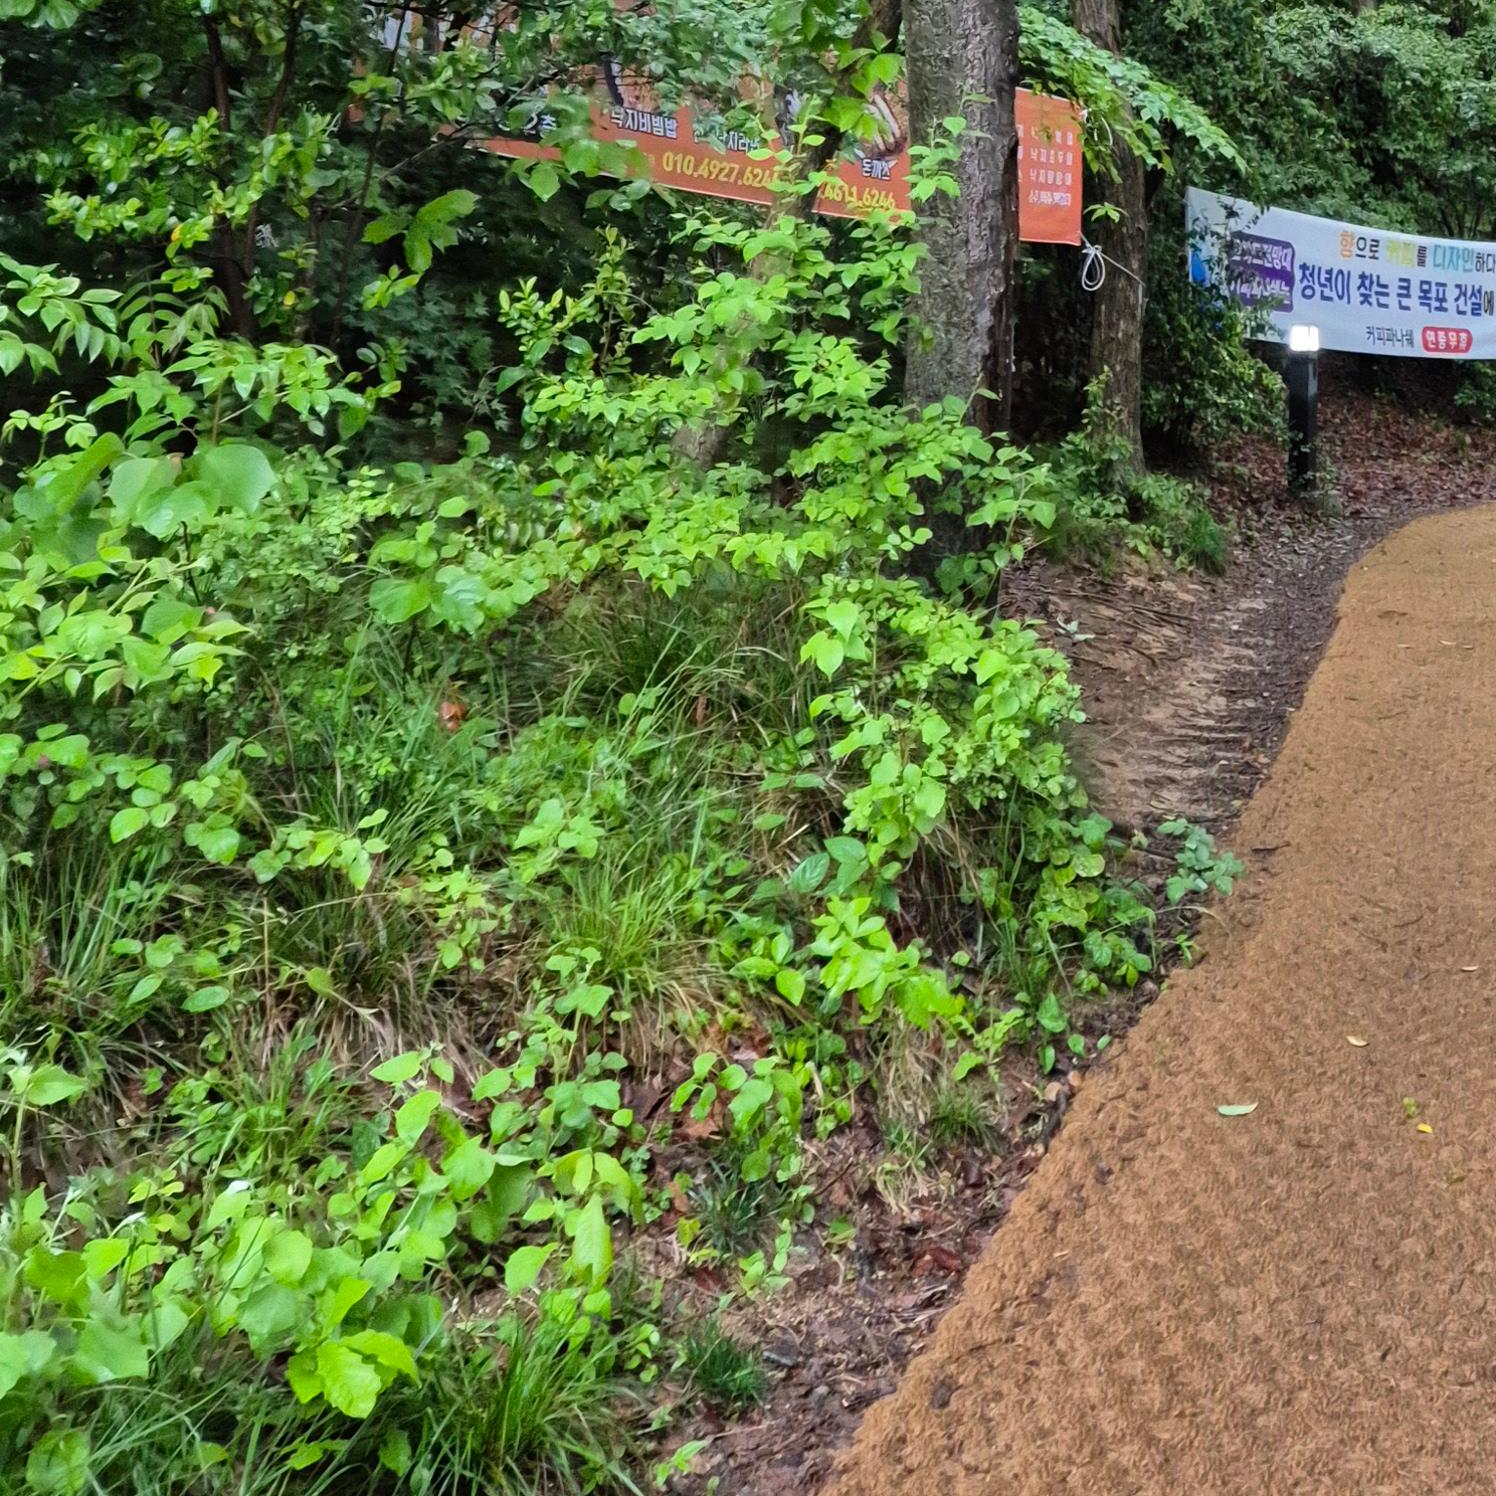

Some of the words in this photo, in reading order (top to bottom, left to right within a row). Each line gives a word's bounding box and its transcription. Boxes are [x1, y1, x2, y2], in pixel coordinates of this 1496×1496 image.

[1340, 231, 1380, 260] 향으로
[1433, 244, 1496, 273] 디자인하다
[1299, 262, 1351, 305] 청년이
[1357, 271, 1390, 309] 찾는
[1396, 277, 1412, 312] 큰
[1418, 279, 1449, 314] 목포
[1454, 281, 1495, 317] 건설에
[1426, 330, 1468, 351] 연중무휴
